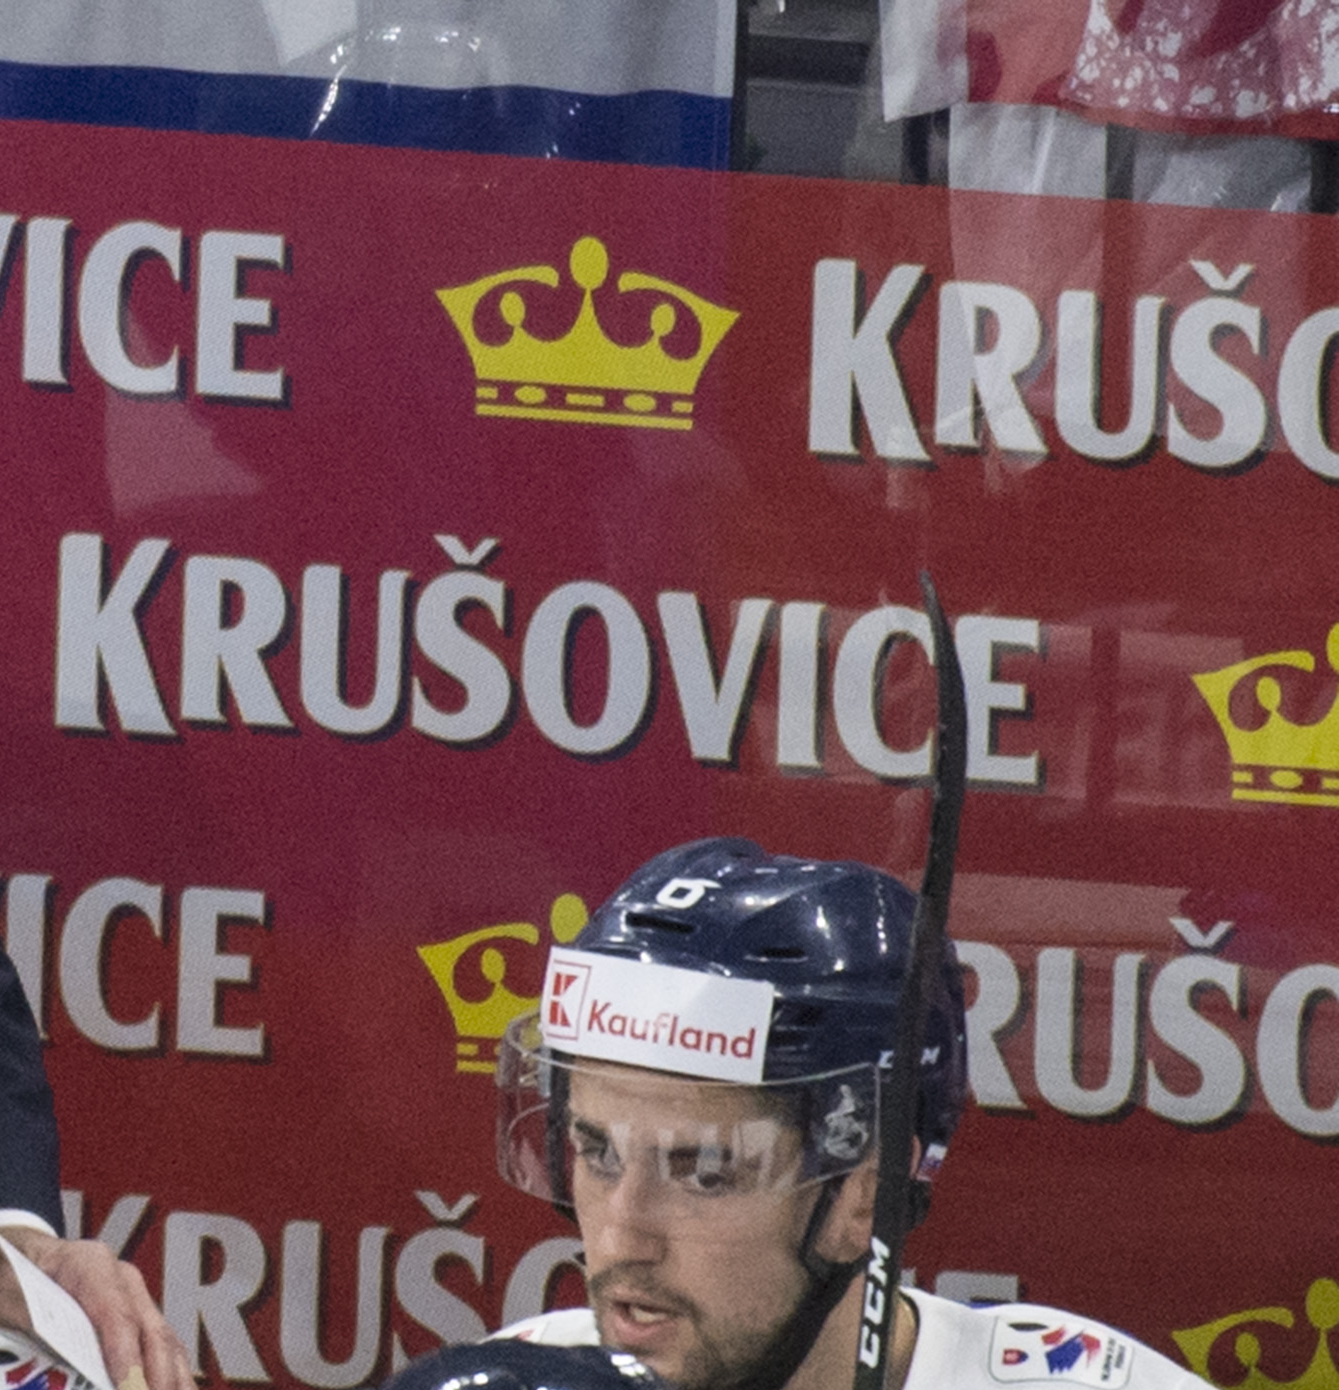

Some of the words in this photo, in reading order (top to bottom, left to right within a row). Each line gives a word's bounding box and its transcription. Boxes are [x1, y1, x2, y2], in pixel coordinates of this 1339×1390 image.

[55, 532, 1039, 786] KRUŠOVICE
[587, 1000, 756, 1060] Kaufland
[859, 1239, 890, 1368] CCM
